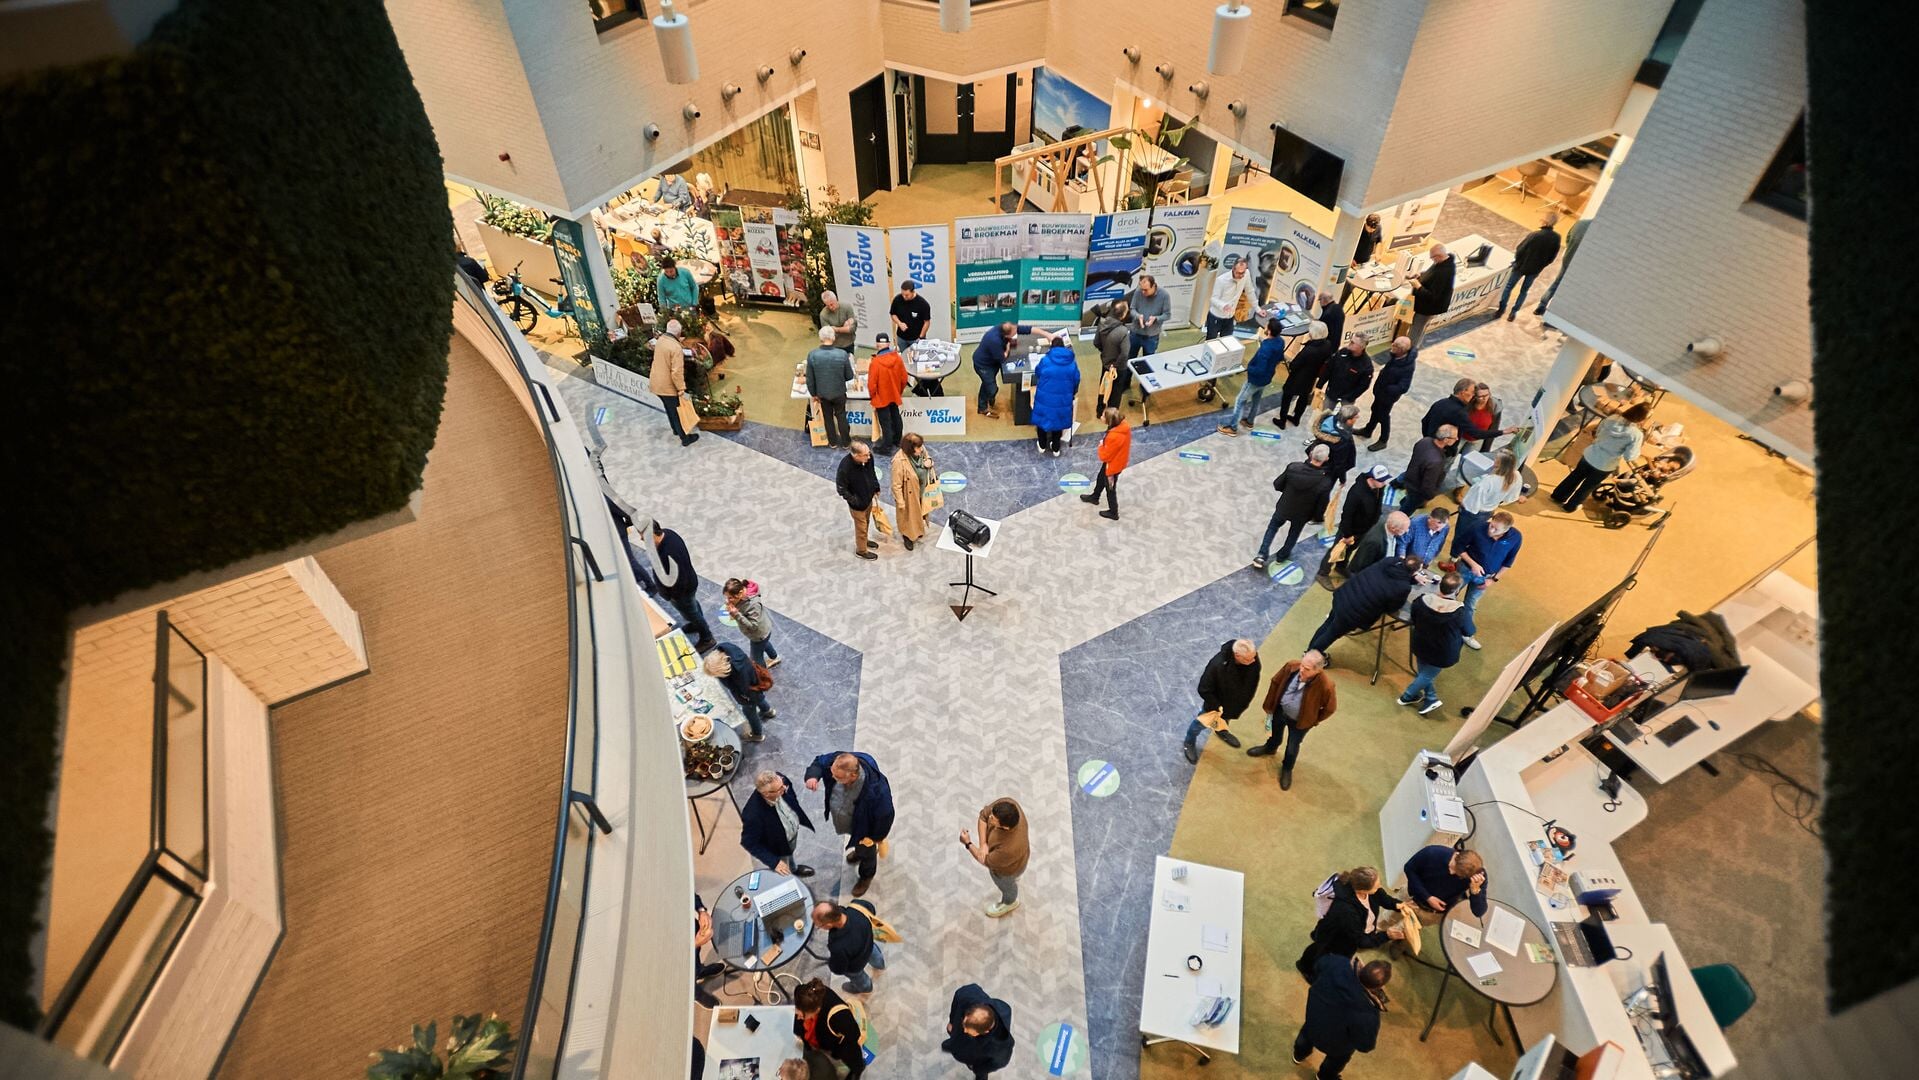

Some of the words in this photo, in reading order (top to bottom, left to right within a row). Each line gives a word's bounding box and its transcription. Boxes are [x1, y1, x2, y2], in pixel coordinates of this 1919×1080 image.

[974, 229, 1018, 238] BROEKMAN
[1118, 217, 1139, 226] drok
[1293, 230, 1320, 249] FALKENA
[847, 250, 863, 287] VAST
[857, 231, 875, 284] BOUW
[909, 253, 923, 289] VAST
[921, 231, 936, 283] BOUW
[853, 293, 868, 329] Vinke
